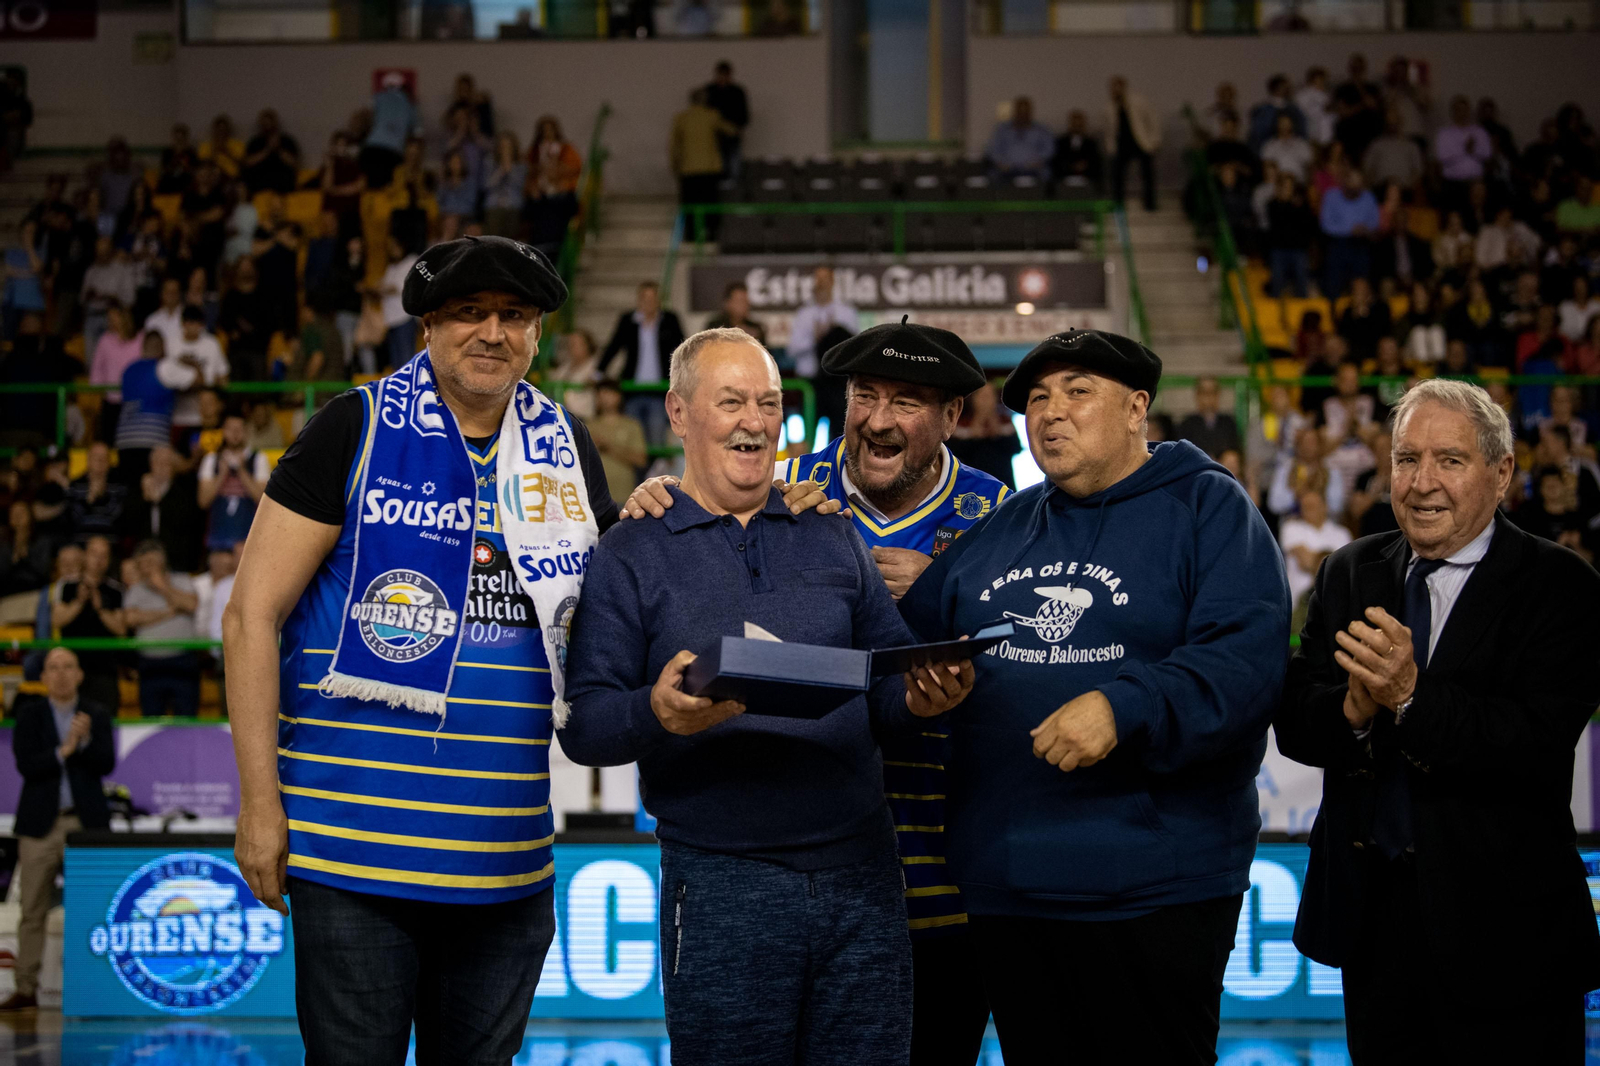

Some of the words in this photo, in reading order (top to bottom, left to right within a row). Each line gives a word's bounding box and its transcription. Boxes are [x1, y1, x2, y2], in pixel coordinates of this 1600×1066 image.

[745, 266, 878, 308] Estrlla
[881, 264, 1006, 305] Galicia
[375, 475, 401, 488] Aguas
[402, 483, 412, 491] de
[419, 530, 441, 542] desde
[443, 535, 460, 547] 1859
[936, 529, 952, 539] Liga
[386, 573, 422, 586] CLUB
[979, 566, 1033, 601] PEÑA
[1039, 561, 1063, 577] OS
[350, 601, 458, 637] OURENSE
[465, 594, 527, 621] alicia
[362, 624, 437, 659] BALONCESTO
[471, 620, 500, 643] 0,0
[999, 639, 1047, 664] Ourense
[1048, 642, 1125, 664] Baloncesto
[90, 907, 284, 955] OURENSE
